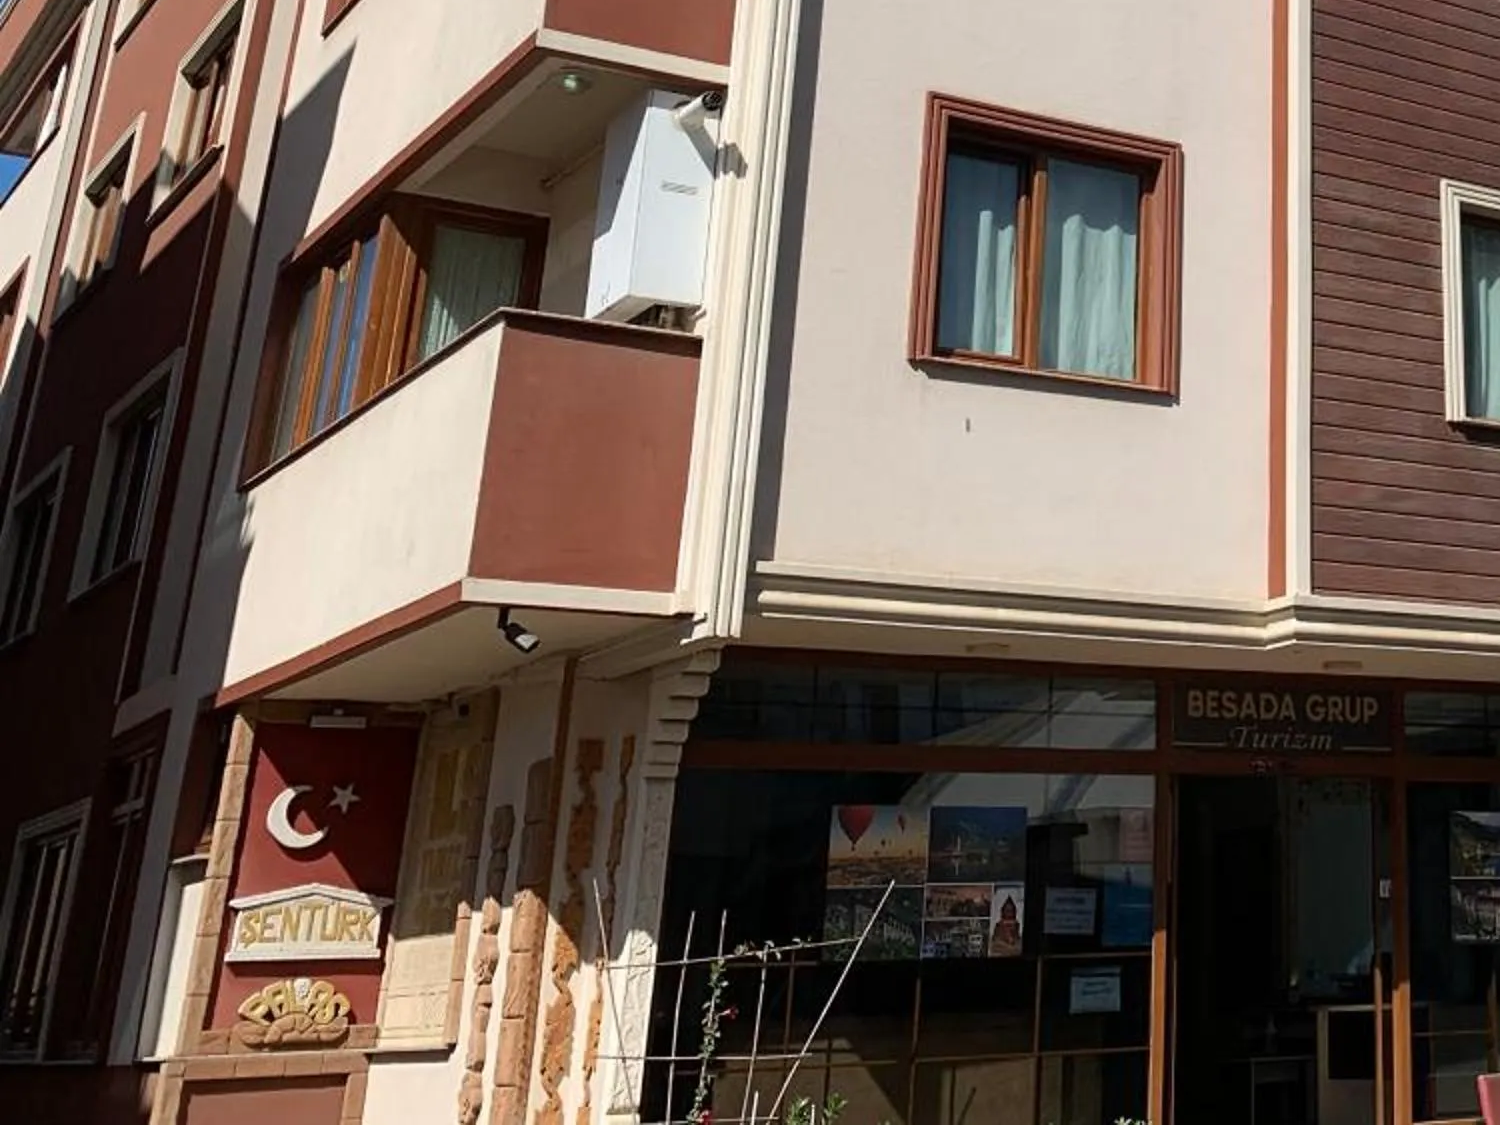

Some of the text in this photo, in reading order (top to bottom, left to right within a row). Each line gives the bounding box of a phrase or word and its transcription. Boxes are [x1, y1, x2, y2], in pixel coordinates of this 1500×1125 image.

[1187, 690, 1379, 724] BESADA GRUP
[1230, 724, 1334, 751] Turizm
